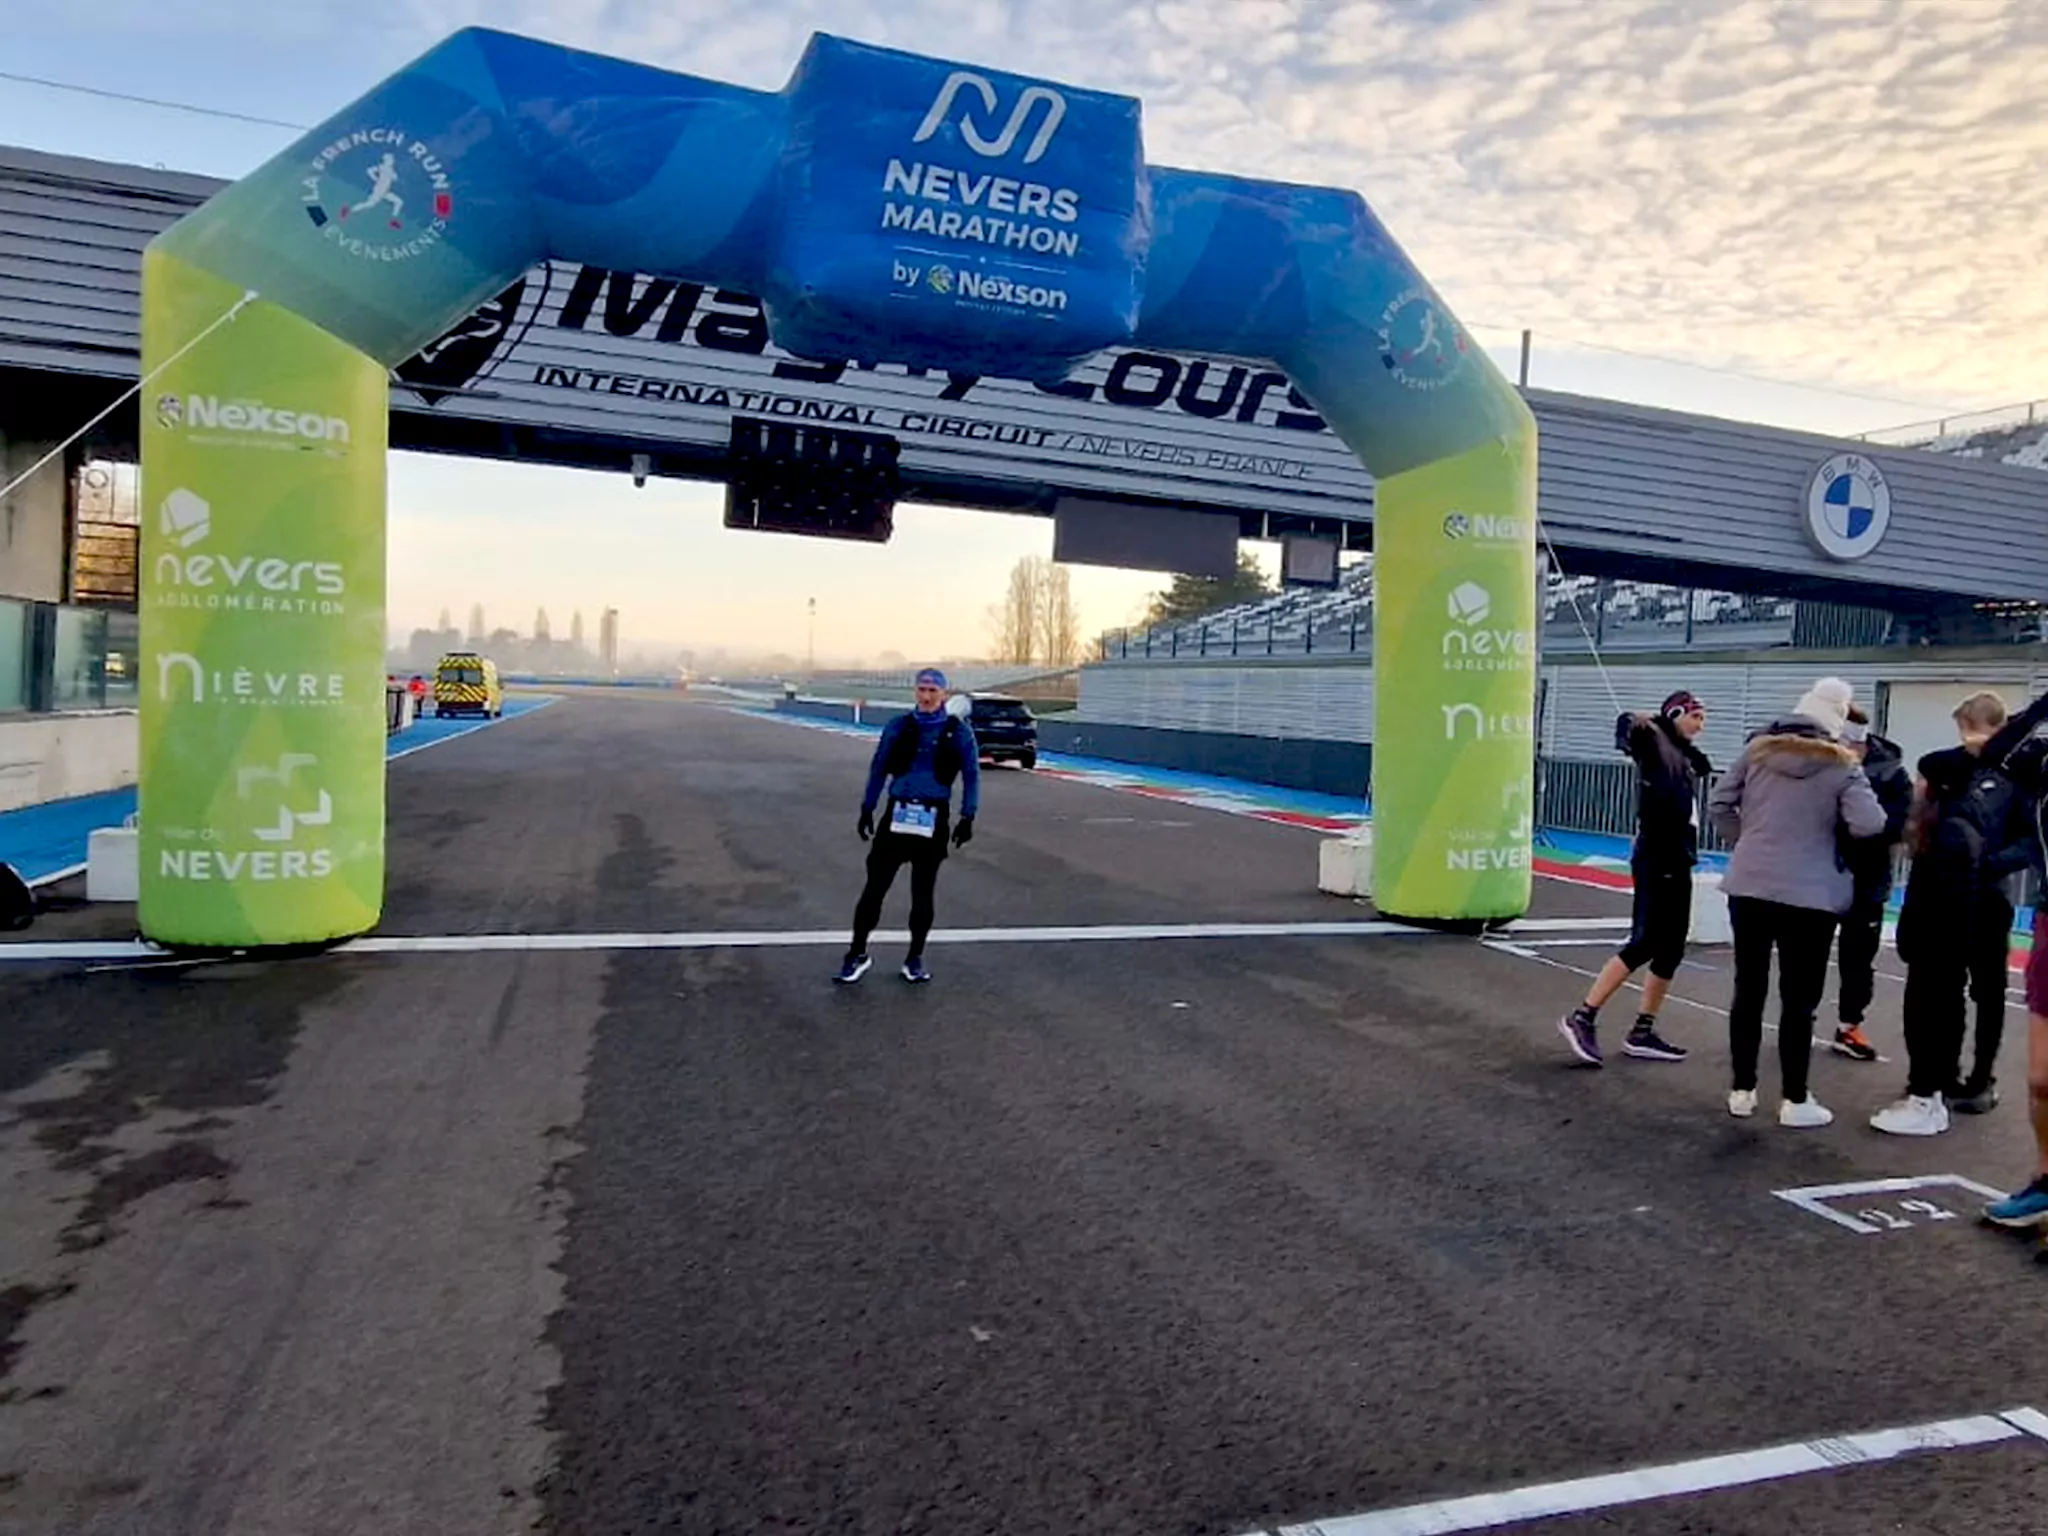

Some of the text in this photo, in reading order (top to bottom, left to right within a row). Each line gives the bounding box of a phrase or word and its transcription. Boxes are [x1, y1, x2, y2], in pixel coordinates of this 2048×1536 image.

[301, 128, 450, 201] LA FRENCH RUN
[883, 158, 1079, 223] NEVERS
[881, 202, 1079, 258] MARATHON
[892, 258, 920, 288] by
[957, 270, 1069, 311] Nexson
[187, 393, 350, 443] Nexson
[1031, 350, 1310, 432] ours
[533, 366, 886, 427] INTERNATIONAL
[901, 412, 1055, 448] CIRCUIT
[1079, 434, 1195, 467] NEVERS
[1201, 451, 1315, 479] FRANCE
[1821, 456, 1883, 489] BMW
[155, 553, 346, 595] nevers
[160, 848, 332, 881] NEVERS
